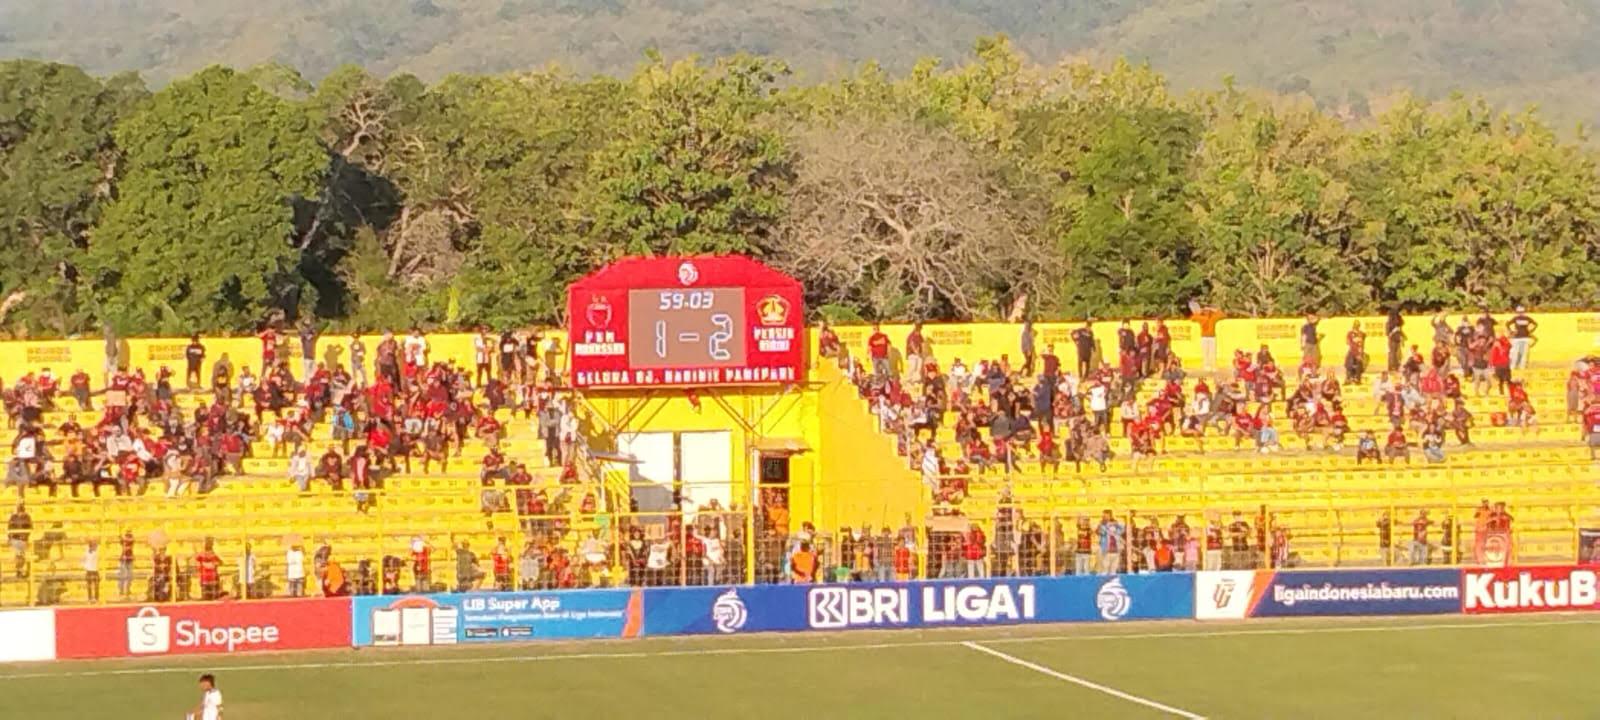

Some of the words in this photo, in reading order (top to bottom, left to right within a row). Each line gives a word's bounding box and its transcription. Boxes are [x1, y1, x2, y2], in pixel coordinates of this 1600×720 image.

[463, 599, 485, 610] LIB
[488, 597, 528, 612] Super
[531, 597, 560, 613] App
[850, 588, 909, 624] BRI
[923, 584, 1035, 622] LIGA1
[1274, 582, 1458, 605] ligaindonesiabaru.com
[176, 620, 280, 652] Shopee
